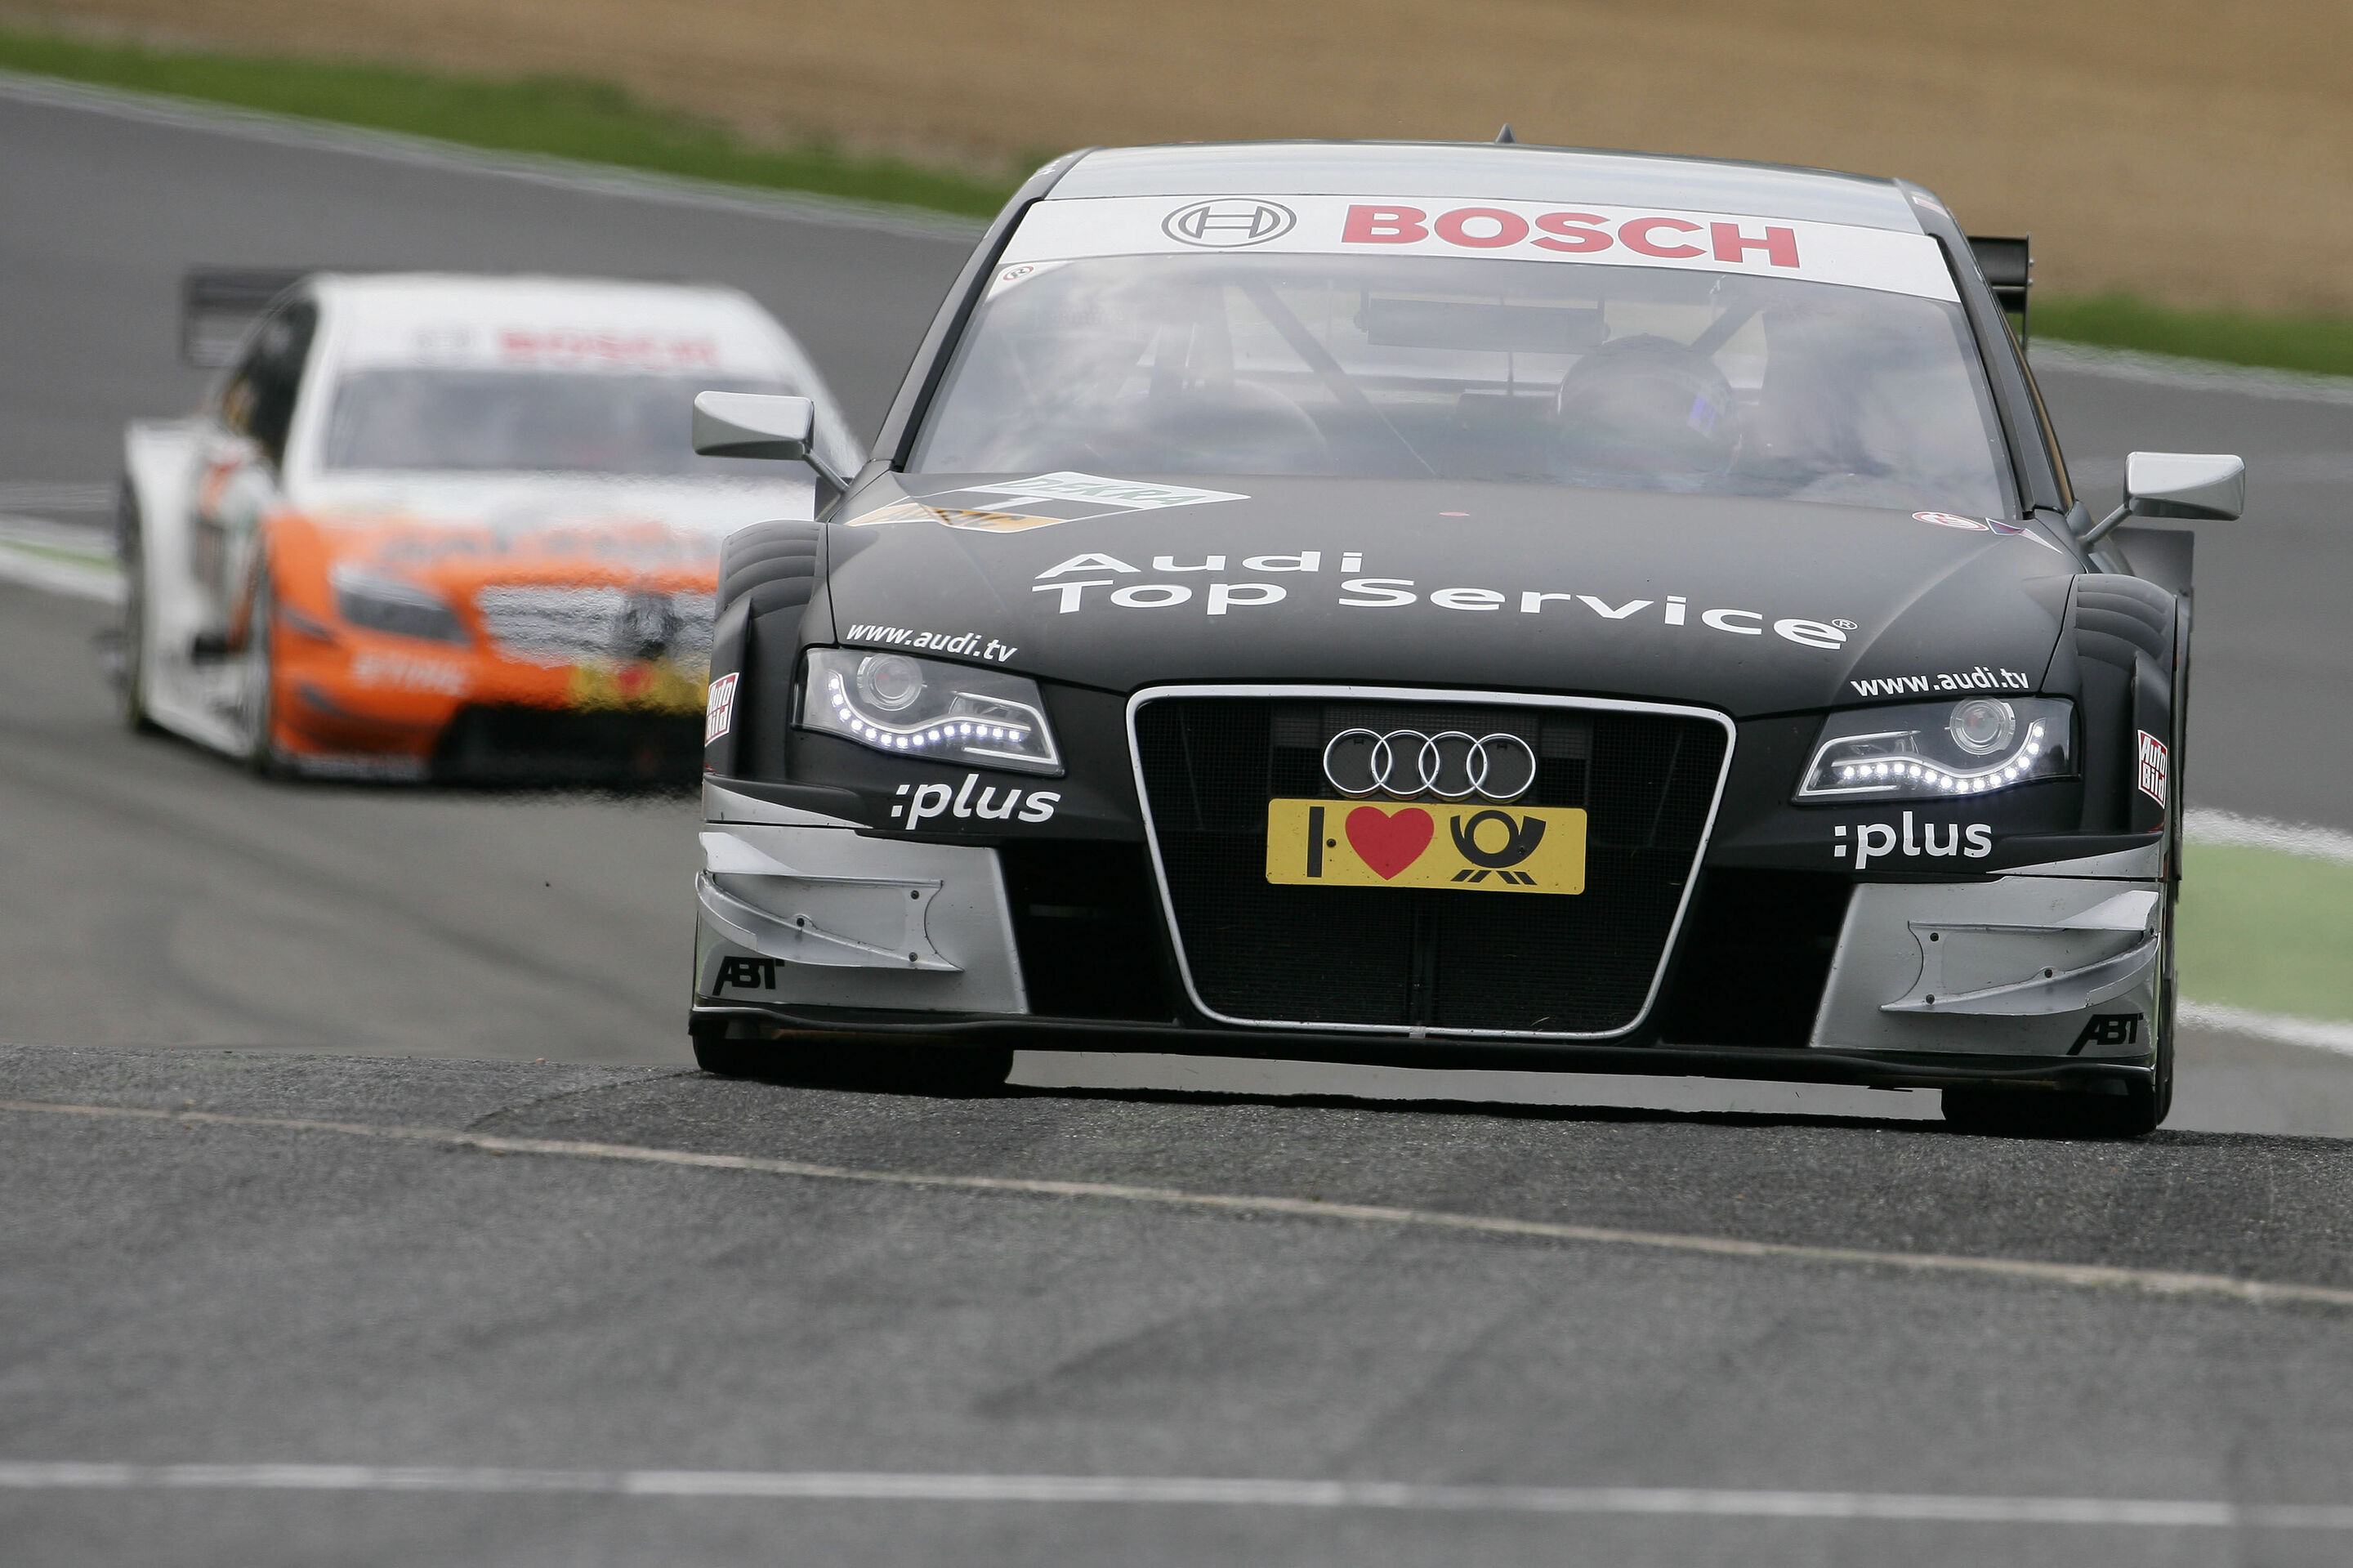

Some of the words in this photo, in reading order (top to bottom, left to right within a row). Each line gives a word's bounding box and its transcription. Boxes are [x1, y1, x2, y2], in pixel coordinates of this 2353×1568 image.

[1342, 204, 1799, 268] BOSCH
[989, 478, 1208, 506] DEKRA
[1034, 551, 1363, 579] Audi
[1032, 579, 1288, 615] Top
[845, 623, 1018, 663] www.audi.tv
[1851, 667, 2030, 697] www.audi.tv
[2141, 735, 2166, 775] Auto
[2142, 762, 2165, 802] Bild
[1306, 806, 1325, 878] I
[712, 956, 784, 996] ABT
[2066, 1013, 2144, 1056] ABT
